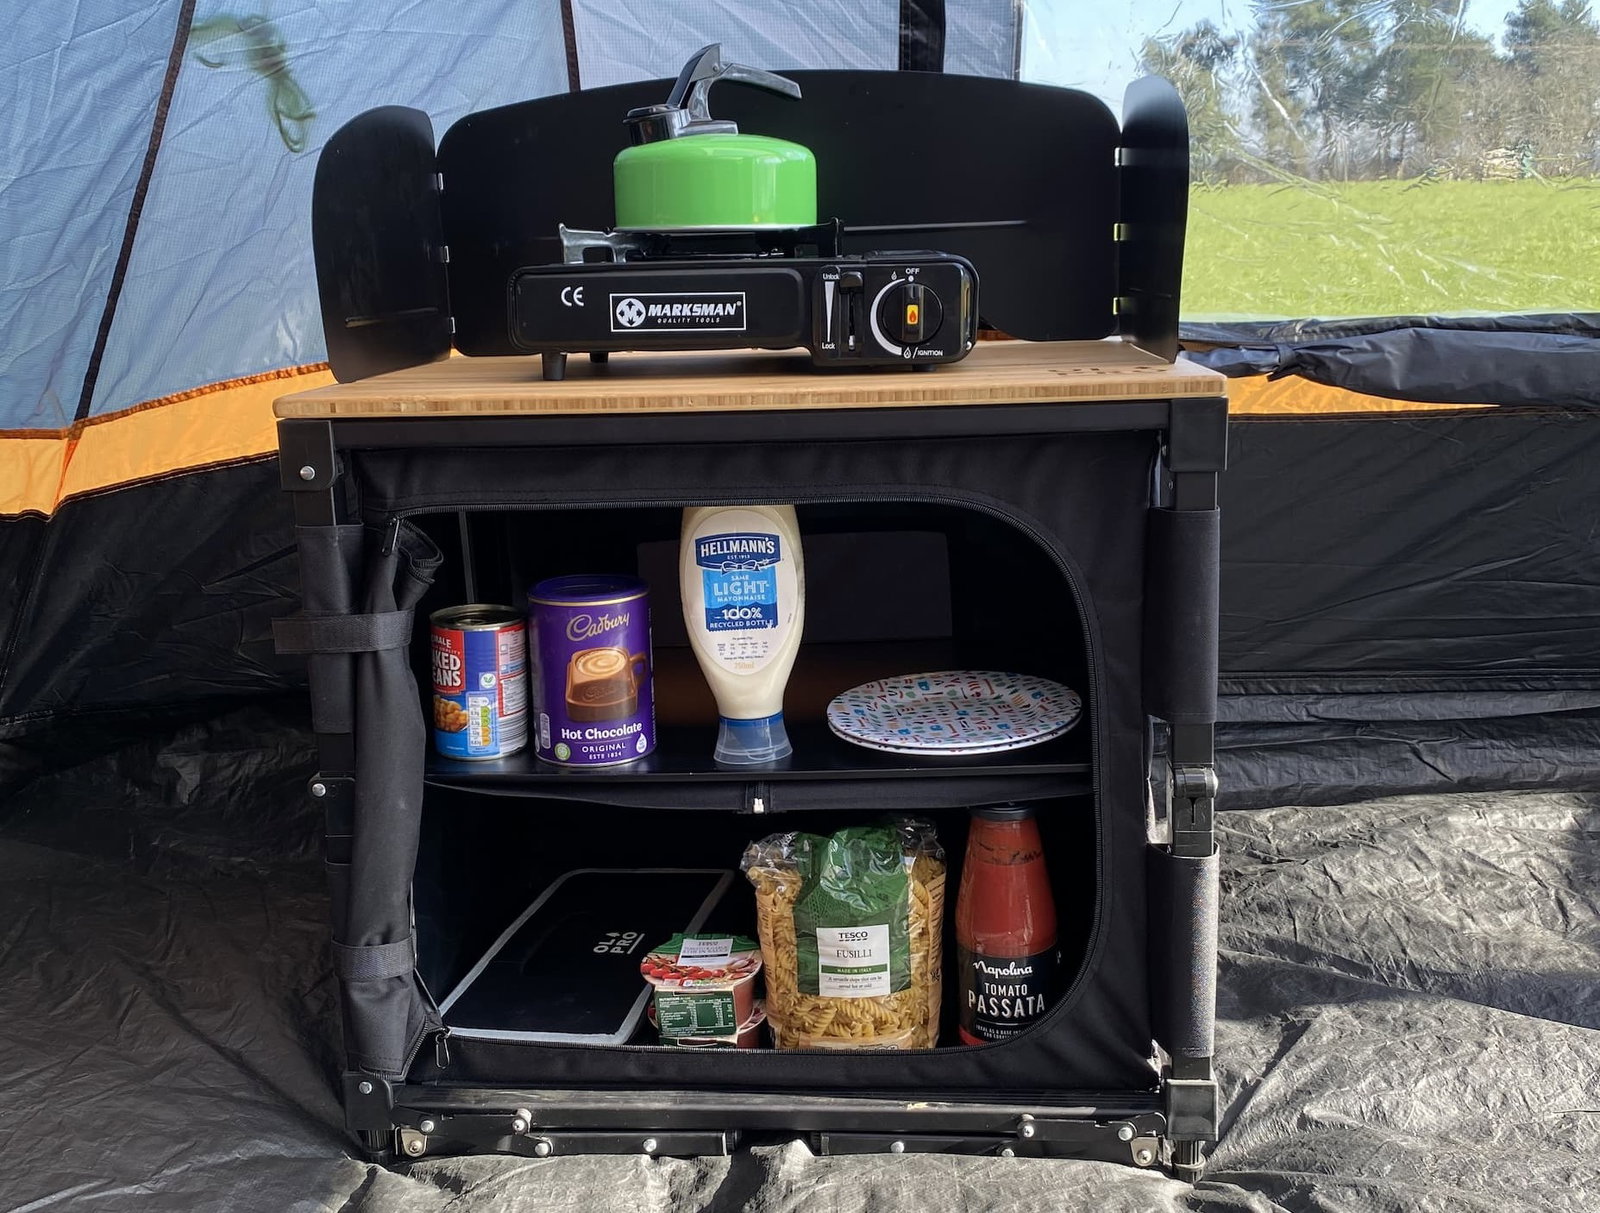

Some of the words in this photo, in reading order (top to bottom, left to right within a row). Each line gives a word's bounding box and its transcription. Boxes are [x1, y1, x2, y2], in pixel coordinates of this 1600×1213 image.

[905, 267, 920, 275] OFF
[561, 286, 585, 307] CE
[695, 316, 721, 324] TOOLS
[821, 342, 836, 350] Lock
[701, 537, 775, 557] HELLMANN'S
[713, 581, 767, 596] LIGHT
[722, 606, 763, 620] 100%
[566, 612, 630, 642] Cadbury
[710, 620, 745, 628] RECYCLED
[746, 619, 774, 627] BOTTLE
[432, 666, 461, 687] EANS
[561, 728, 582, 740] Hot
[585, 722, 642, 739] Chocolate
[582, 742, 626, 753] ORIGINAL
[610, 932, 638, 953] PRO
[838, 931, 868, 940] TESCO
[836, 949, 872, 959] FUSILLI
[973, 960, 1033, 979] Napolina
[984, 982, 1028, 996] TOMATO
[968, 989, 1045, 1019] PASSATA
